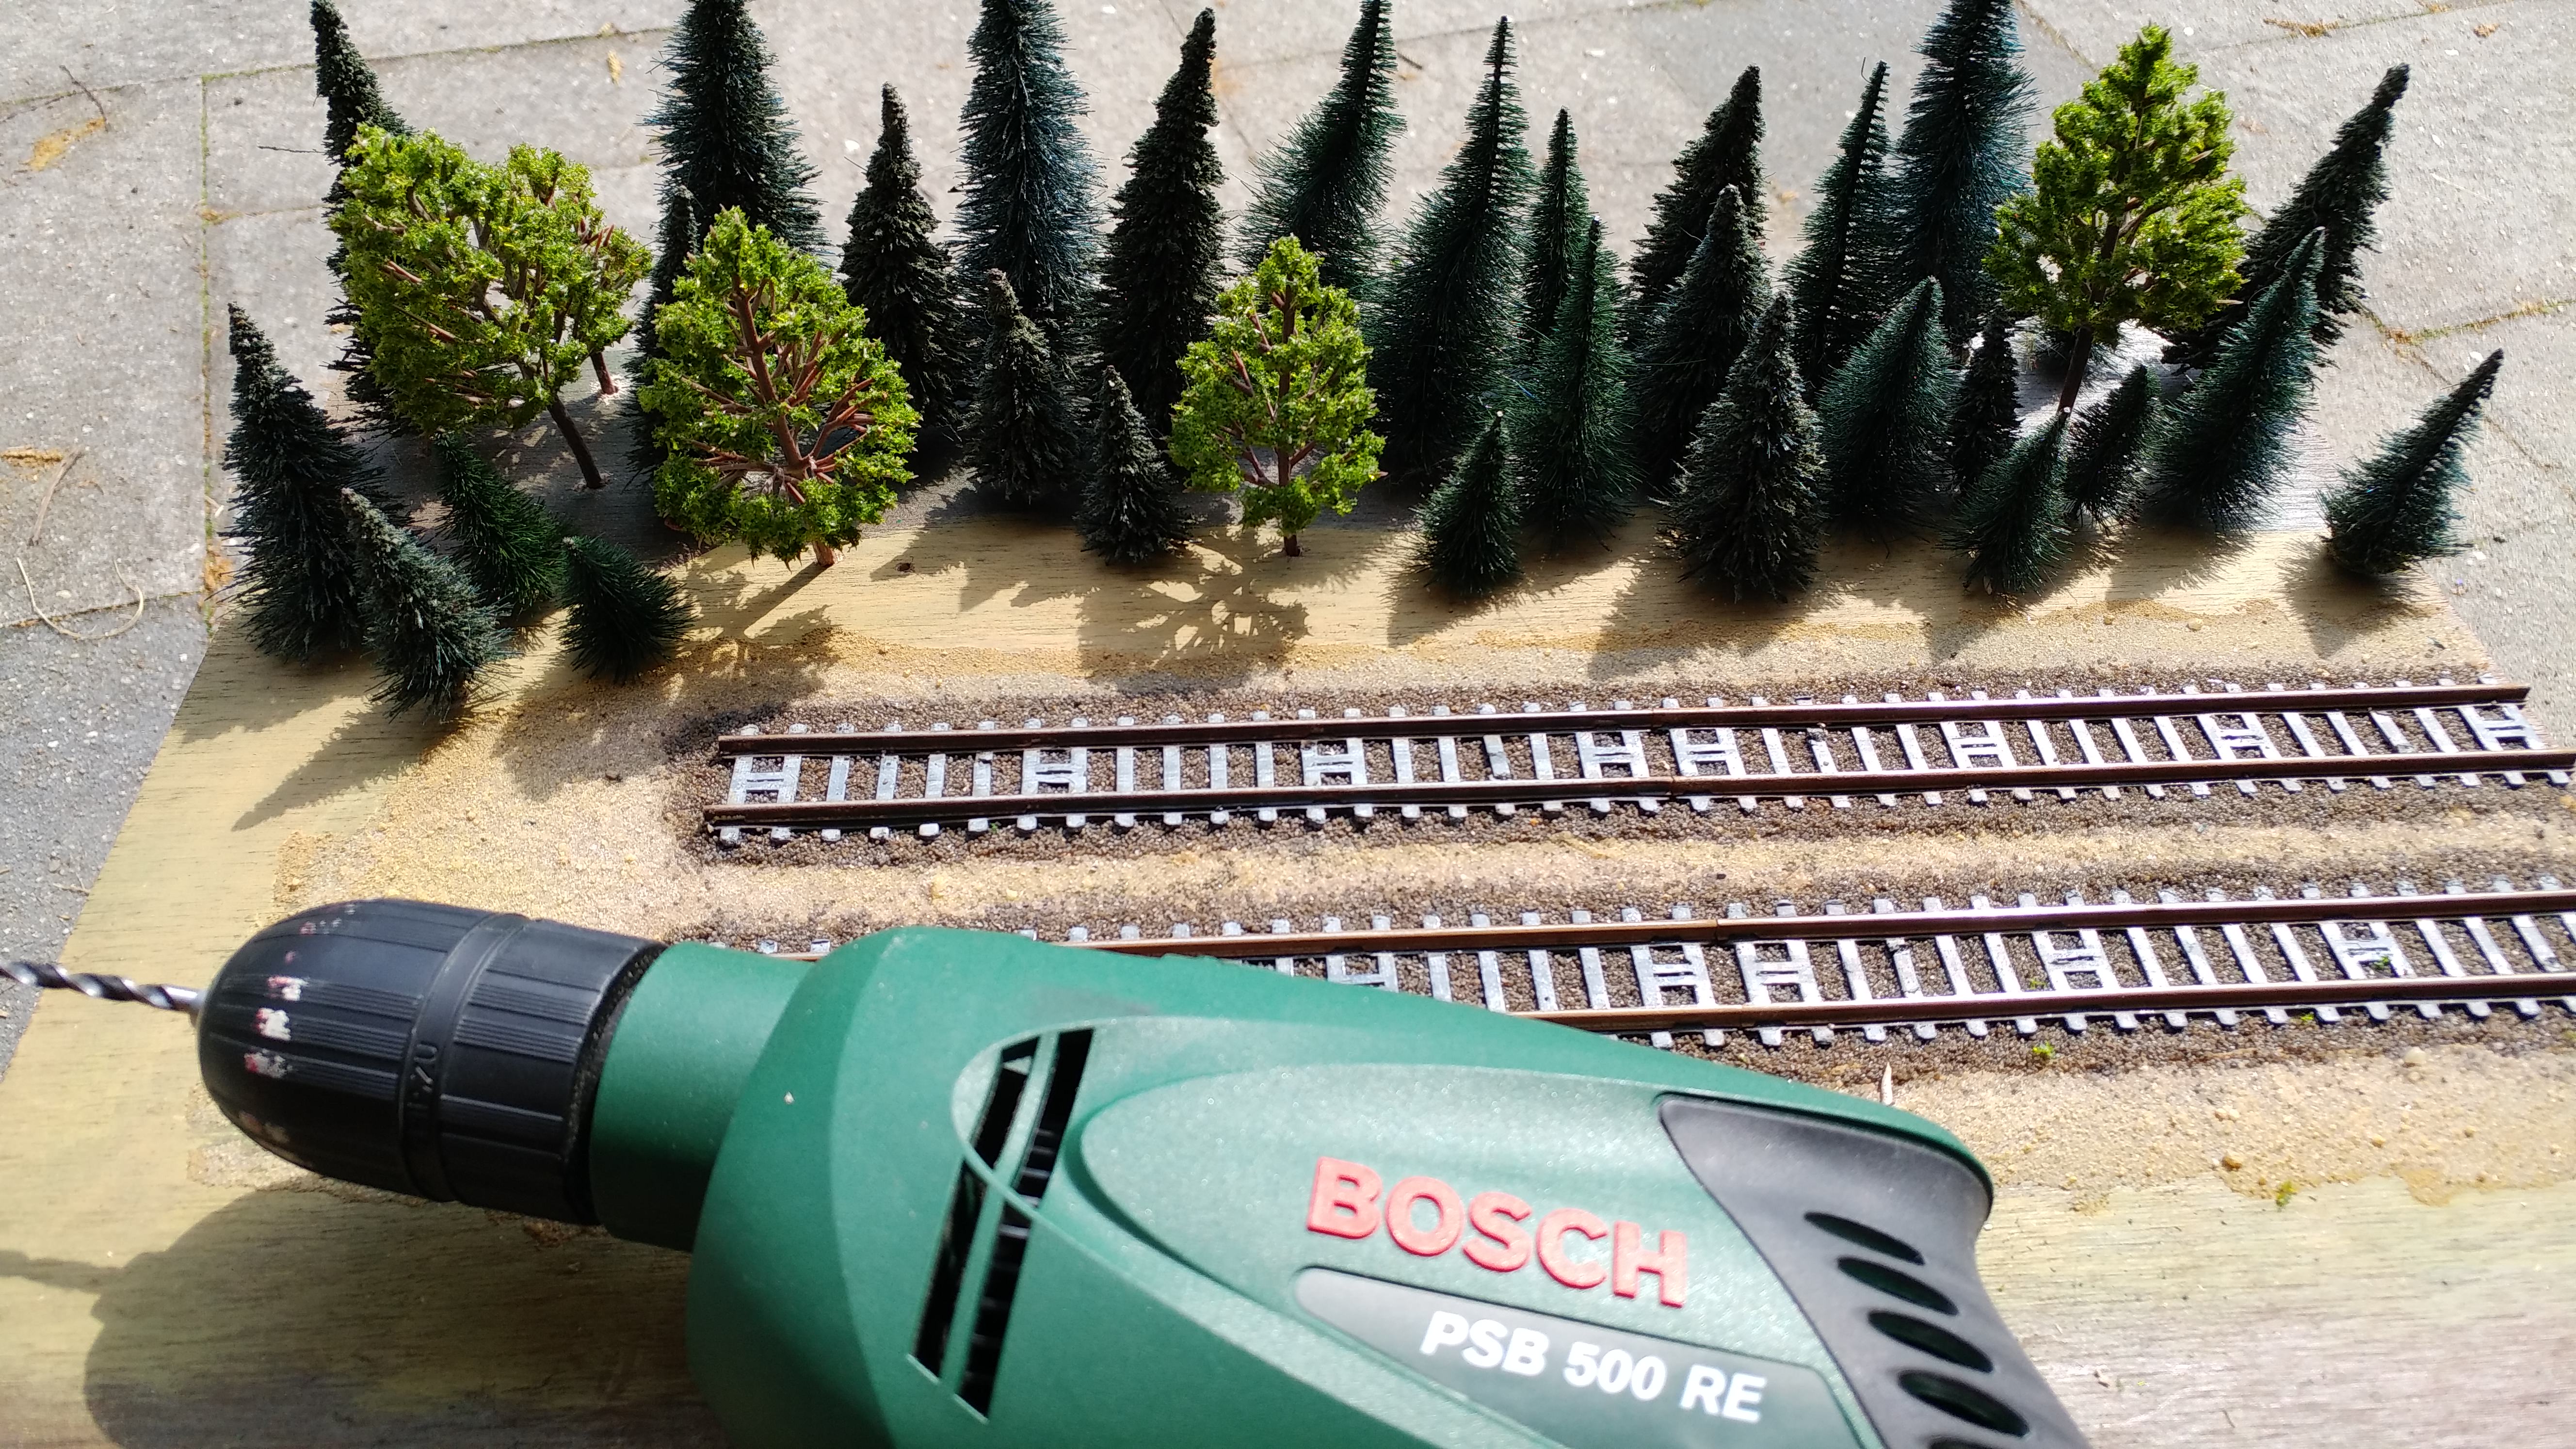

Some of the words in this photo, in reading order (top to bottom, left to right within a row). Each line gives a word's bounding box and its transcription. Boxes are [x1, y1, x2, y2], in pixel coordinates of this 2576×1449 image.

[1306, 1156, 1687, 1308] BOSCH
[1420, 1311, 1550, 1377] PSB
[1563, 1342, 1667, 1401] 500
[1679, 1364, 1768, 1423] RE
